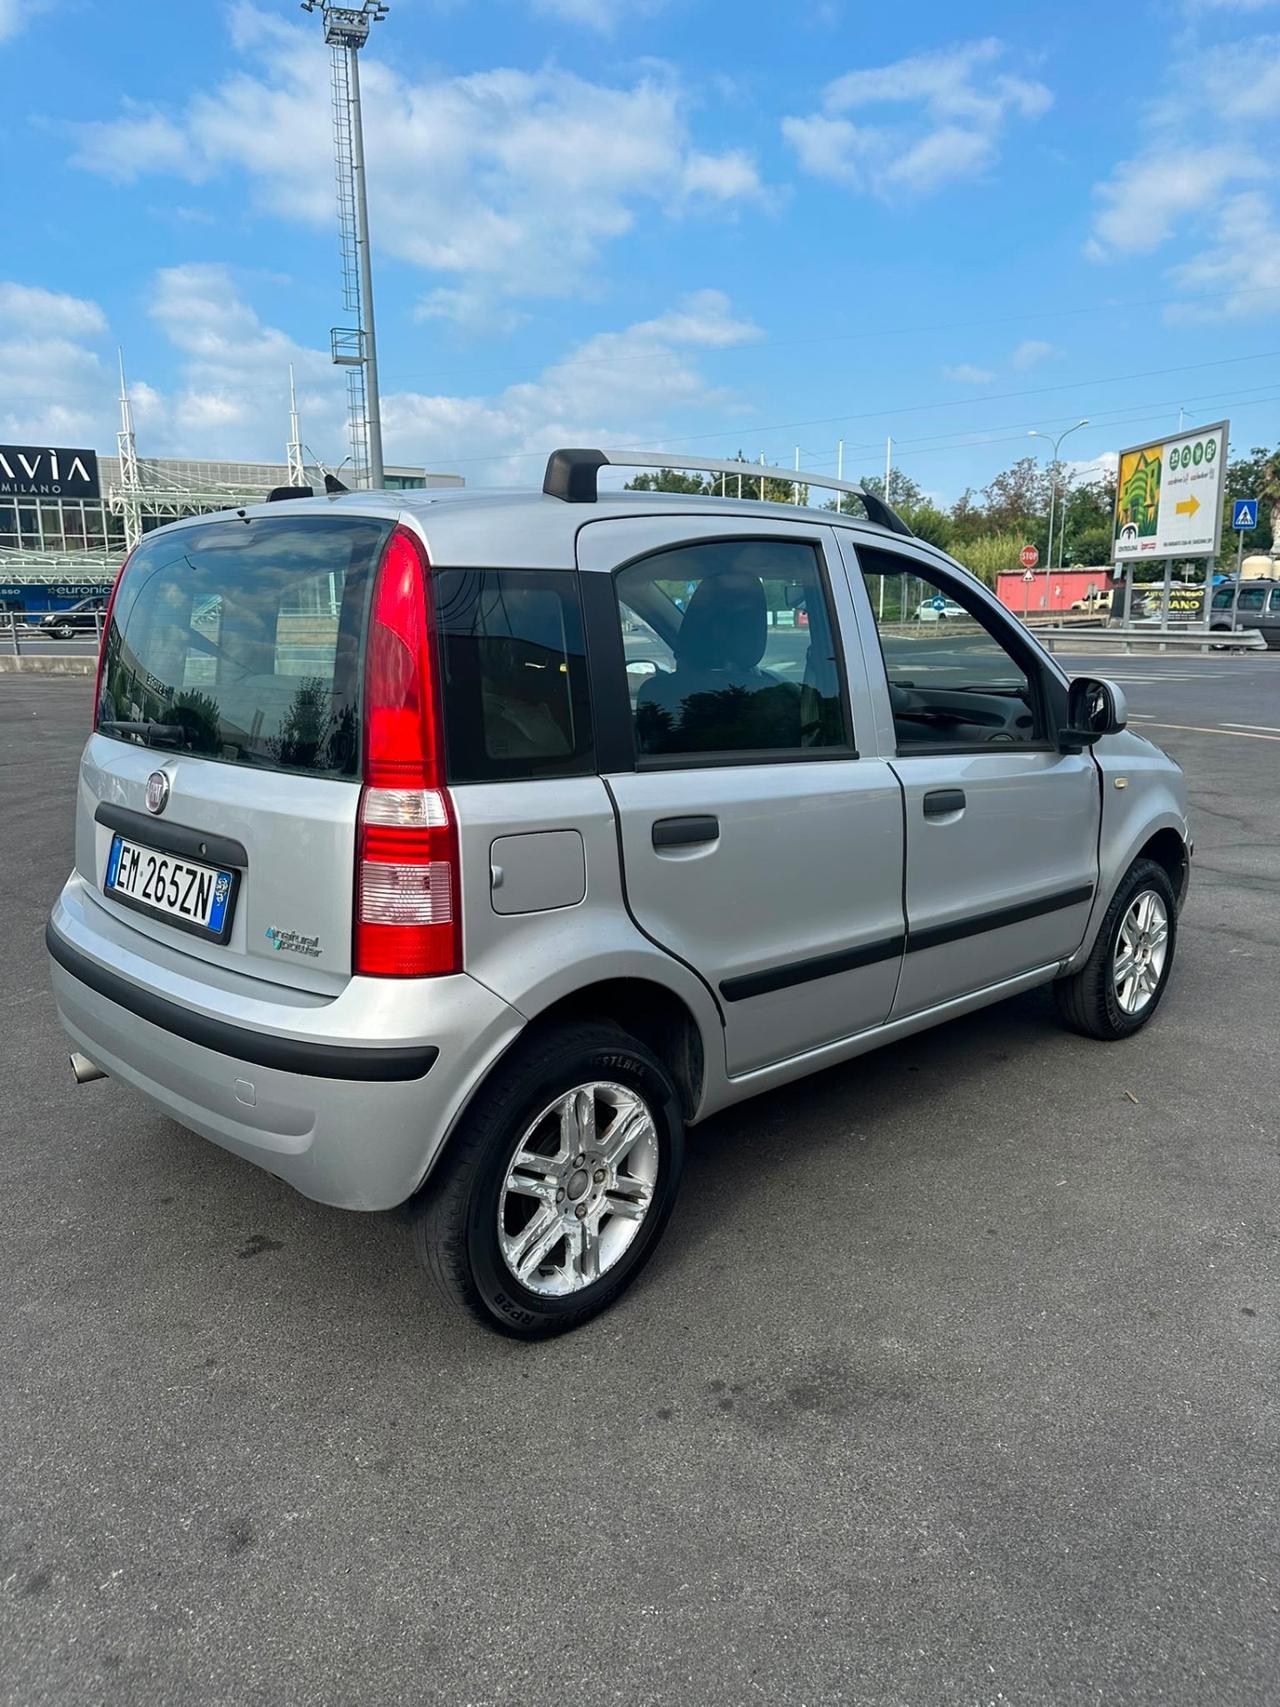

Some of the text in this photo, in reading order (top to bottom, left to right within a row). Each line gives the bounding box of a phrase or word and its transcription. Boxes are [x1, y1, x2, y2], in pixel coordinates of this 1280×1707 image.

[1, 483, 61, 493] MILANO
[1022, 552, 1037, 560] STOP
[56, 585, 112, 595] euronic
[116, 846, 213, 920] EM 265ZN
